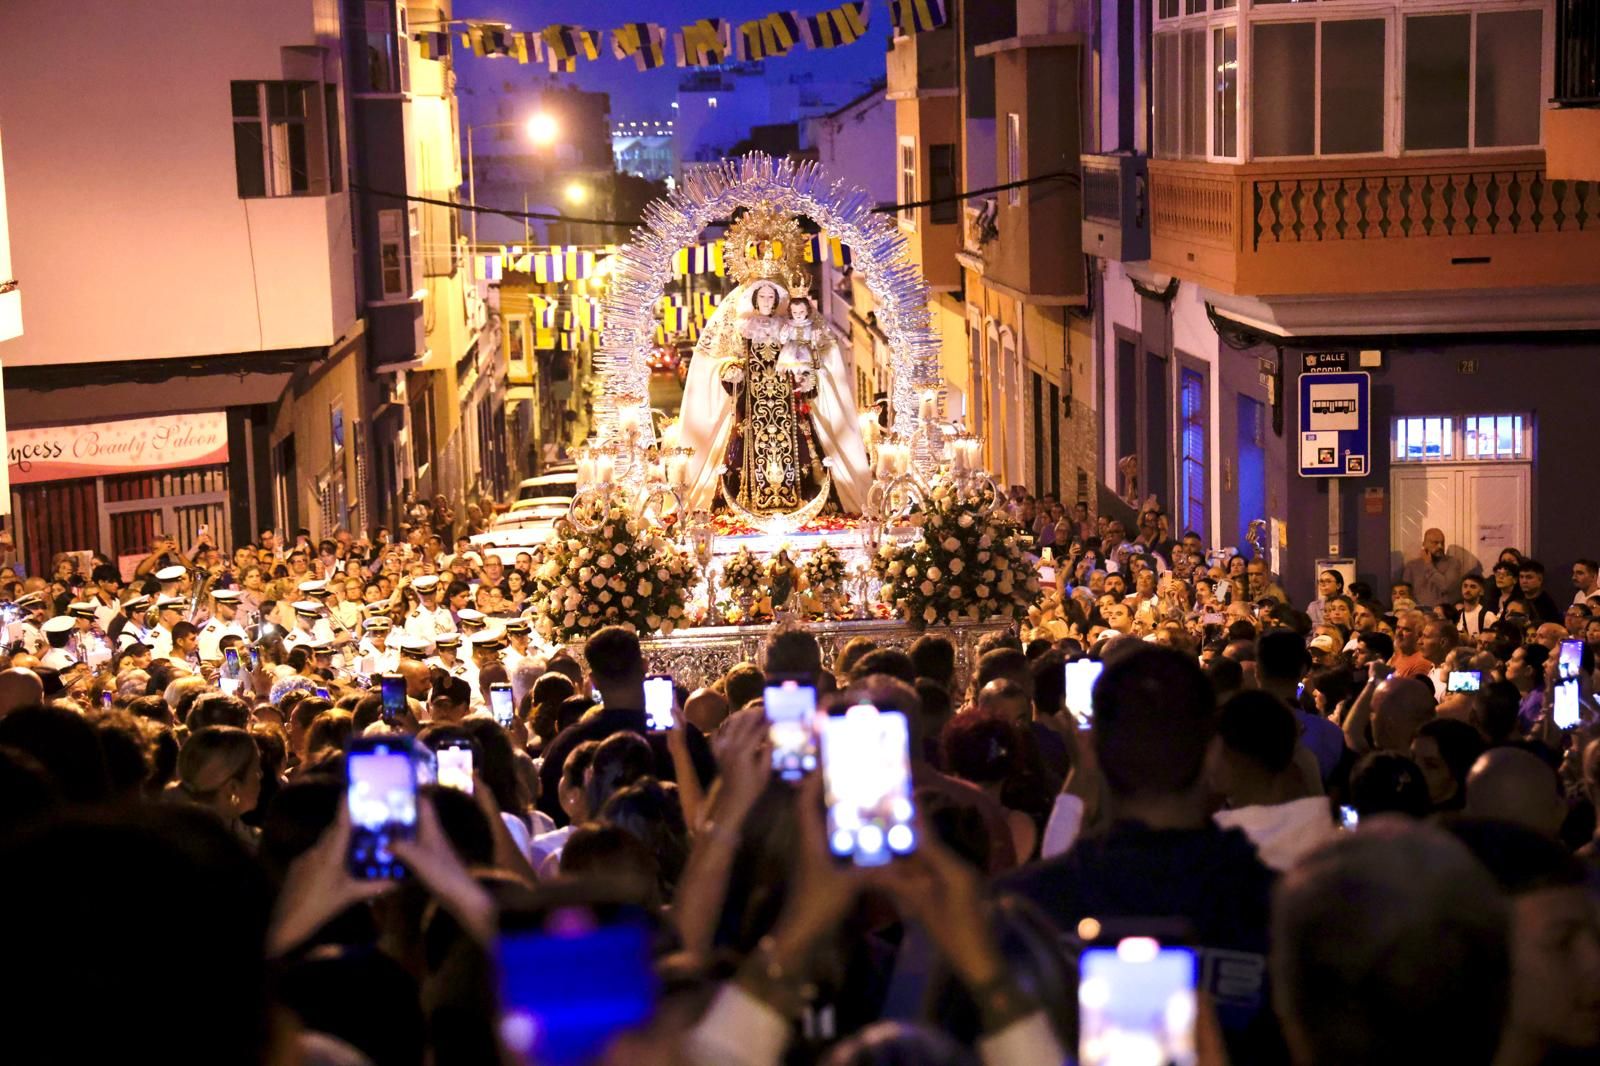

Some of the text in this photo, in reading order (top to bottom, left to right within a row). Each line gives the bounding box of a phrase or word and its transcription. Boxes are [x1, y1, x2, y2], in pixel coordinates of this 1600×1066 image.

[1320, 353, 1345, 361] CALLE
[8, 425, 217, 472] ncess Beauty Saloon
